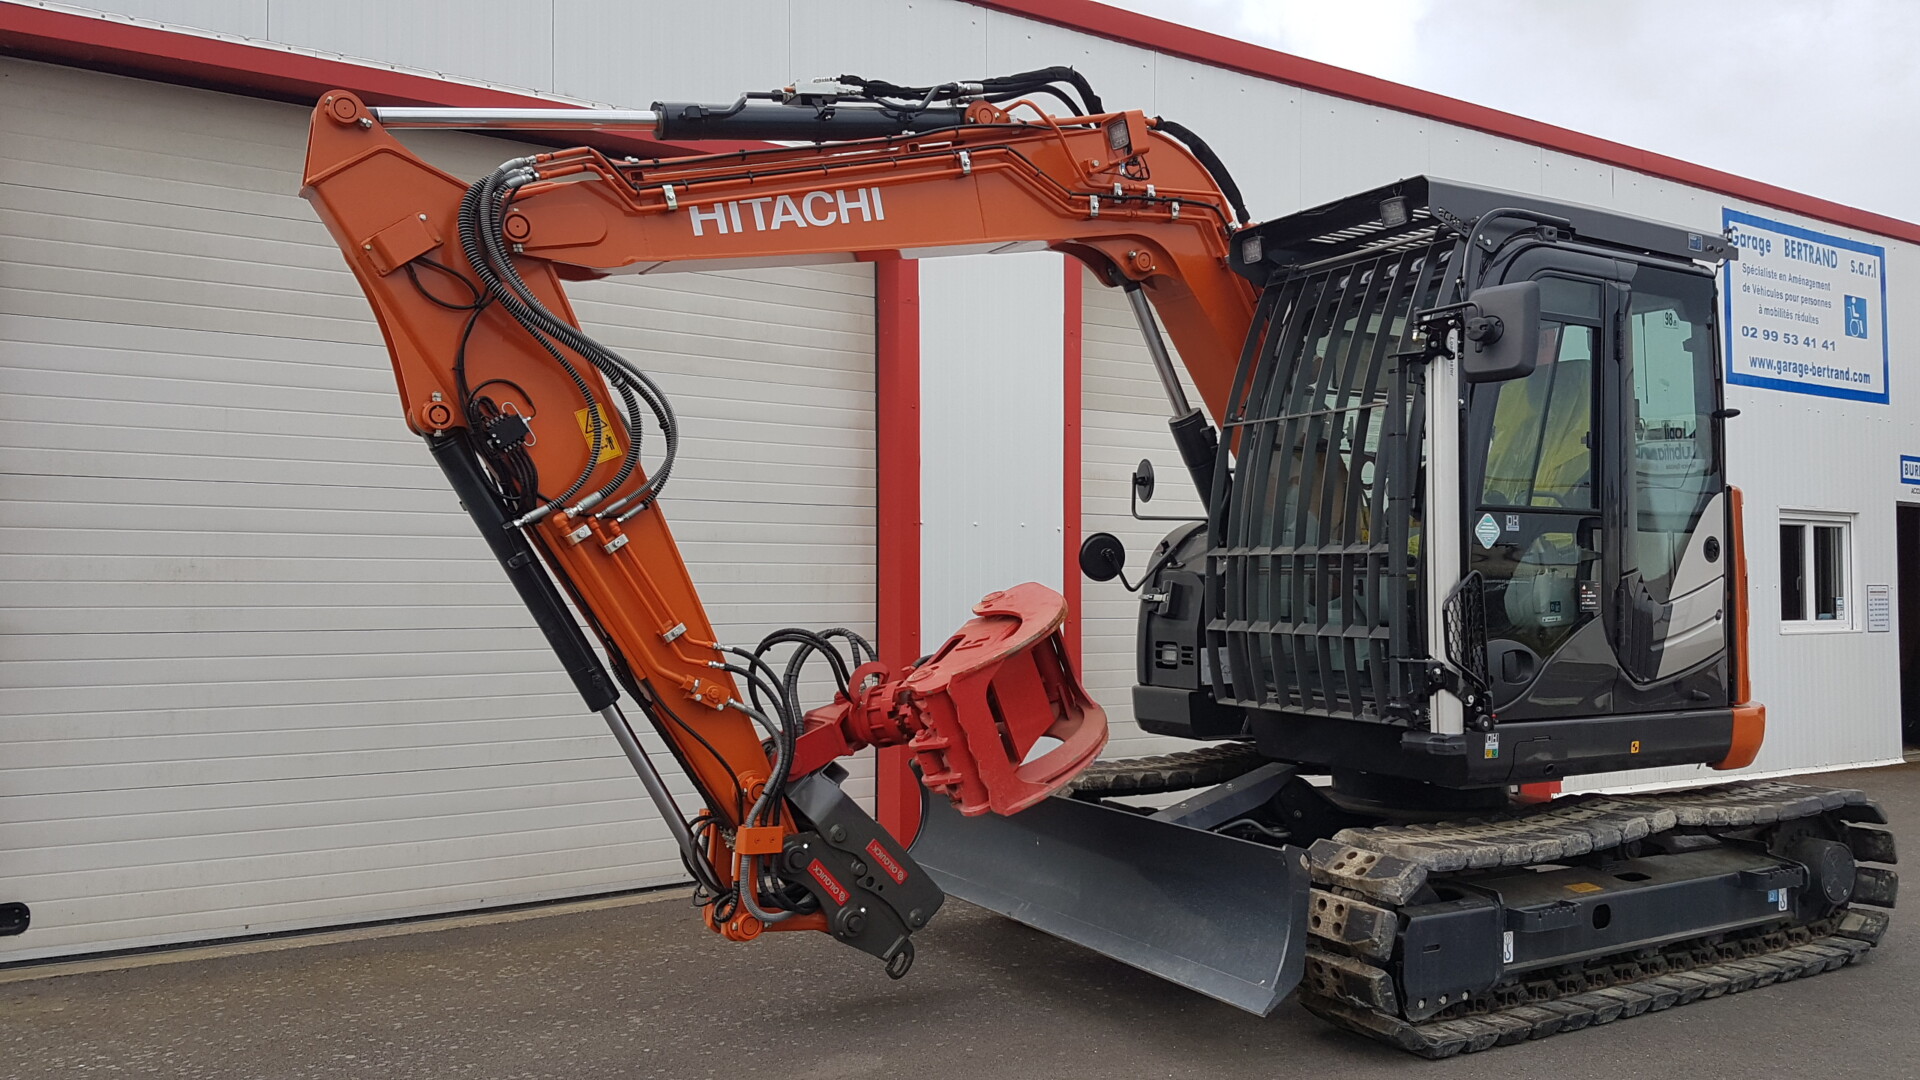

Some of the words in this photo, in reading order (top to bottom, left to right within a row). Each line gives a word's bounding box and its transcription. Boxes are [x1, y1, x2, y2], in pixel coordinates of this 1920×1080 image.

[688, 187, 885, 236] HITACHI
[1731, 225, 1771, 257] Garage
[1784, 238, 1838, 268] BERTRAND
[1742, 263, 1777, 280] Spécialiste
[1779, 272, 1787, 281] en
[1788, 273, 1831, 291] Aménagement
[1742, 283, 1750, 293] de
[1752, 283, 1783, 299] Véhicules
[1785, 292, 1799, 302] pour
[1800, 296, 1832, 308] personnes
[1764, 306, 1793, 320] mobilités
[1794, 311, 1819, 325] réduites
[1741, 326, 1758, 338] 02
[1762, 329, 1779, 342] 99
[1783, 333, 1799, 345] 53
[1803, 337, 1817, 348] 41
[1821, 340, 1836, 351] 41
[1749, 356, 1871, 384] www.garage-bertrand.com
[1904, 463, 1920, 477] BUR
[871, 844, 898, 874] OILQUICK
[812, 864, 839, 895] OILQUICK
